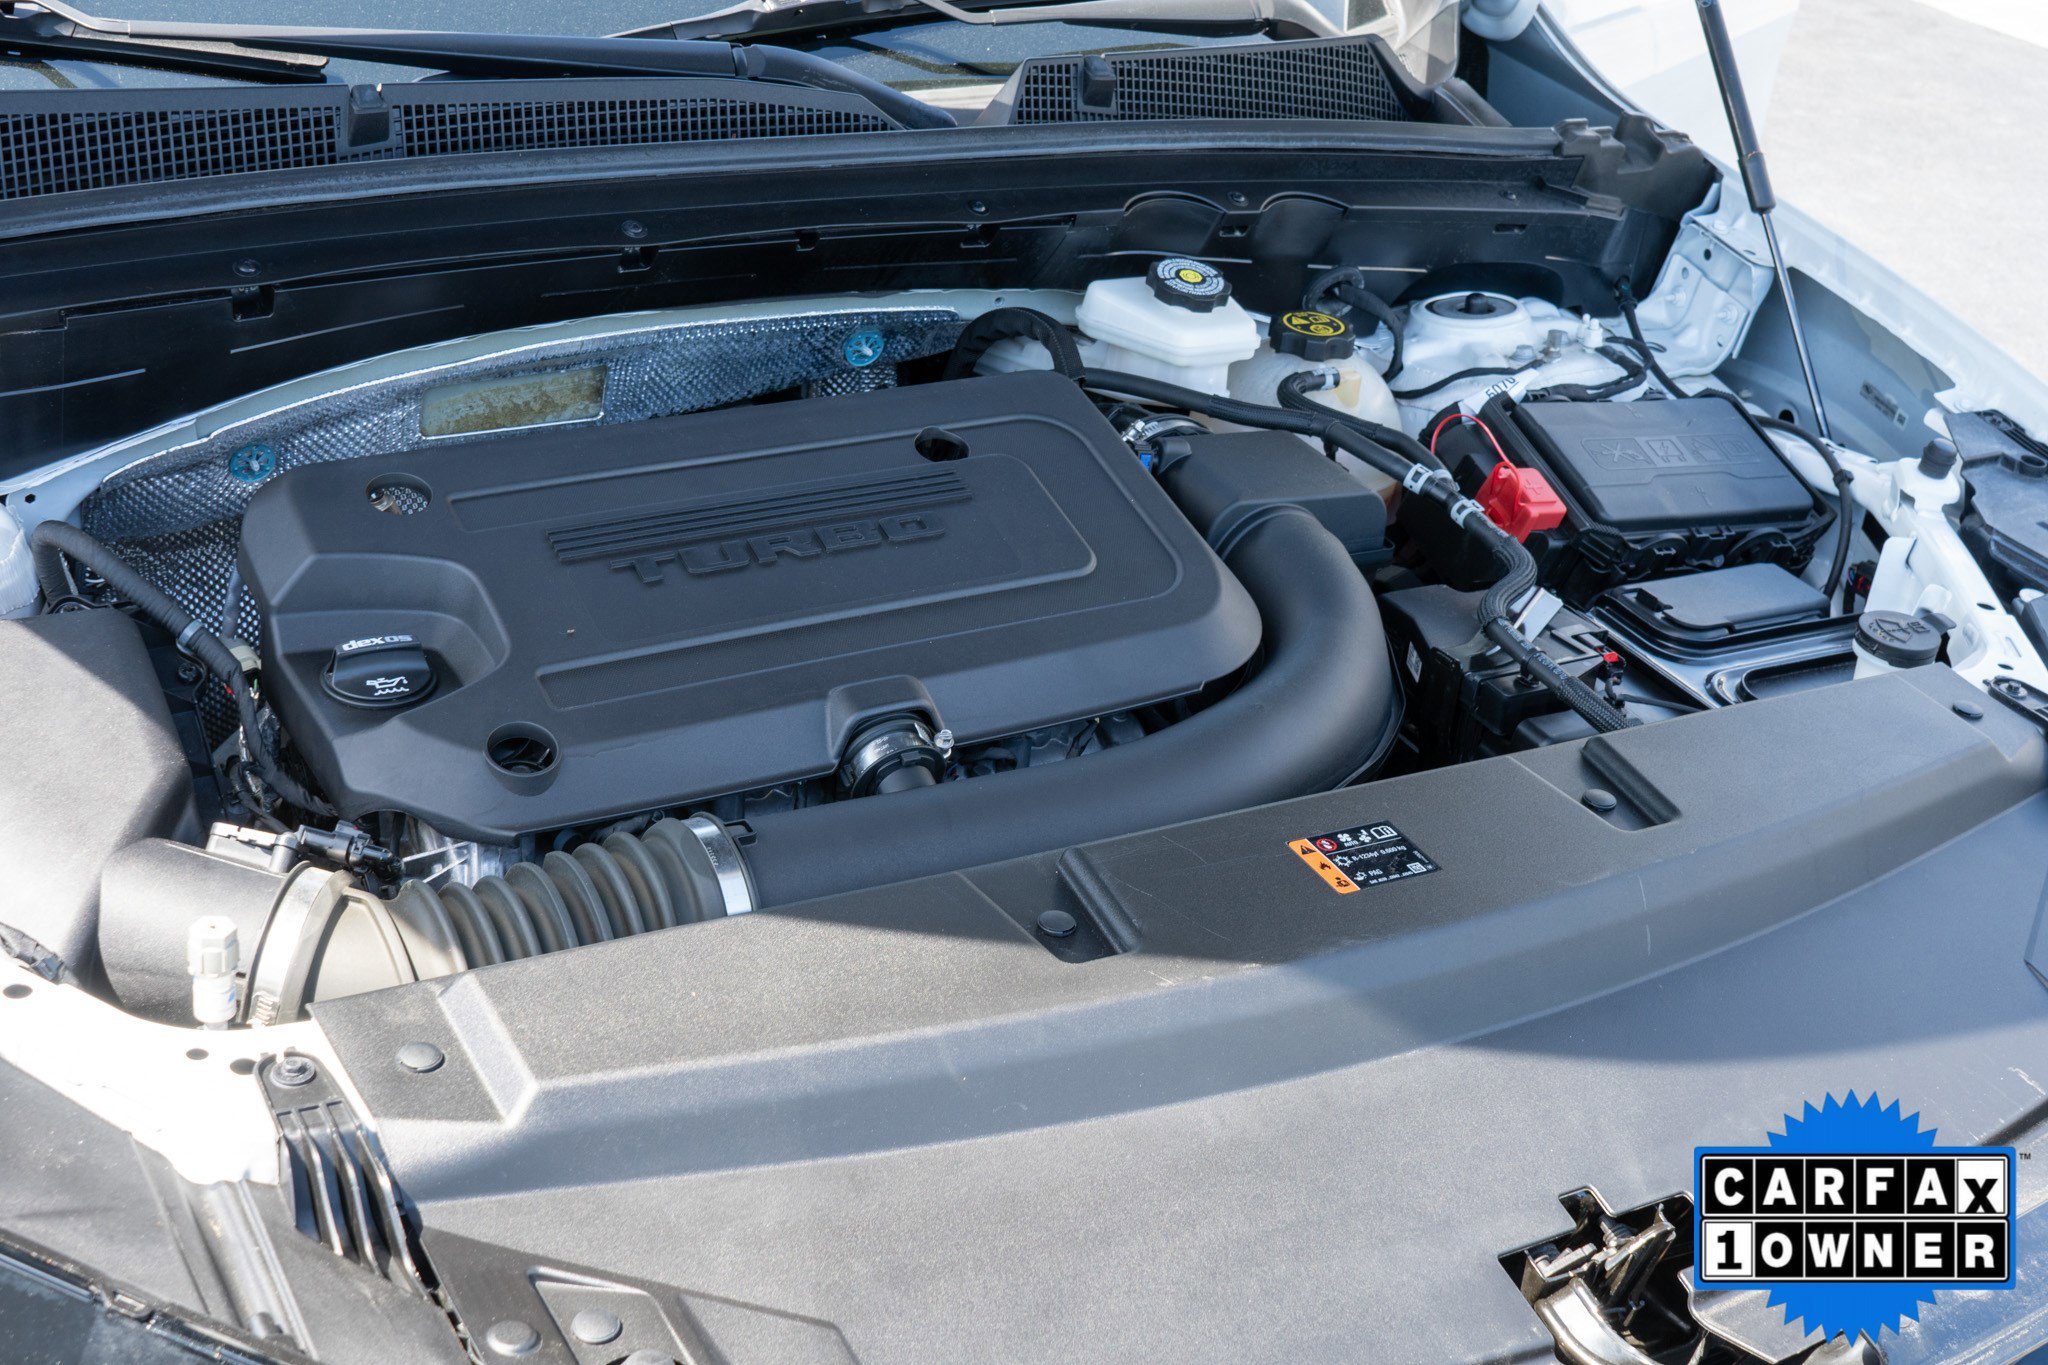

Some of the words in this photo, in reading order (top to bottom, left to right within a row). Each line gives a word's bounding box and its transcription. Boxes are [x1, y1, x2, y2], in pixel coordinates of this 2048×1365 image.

[608, 511, 947, 584] TURBO
[342, 634, 413, 651] dexos
[1368, 868, 1383, 876] PAG
